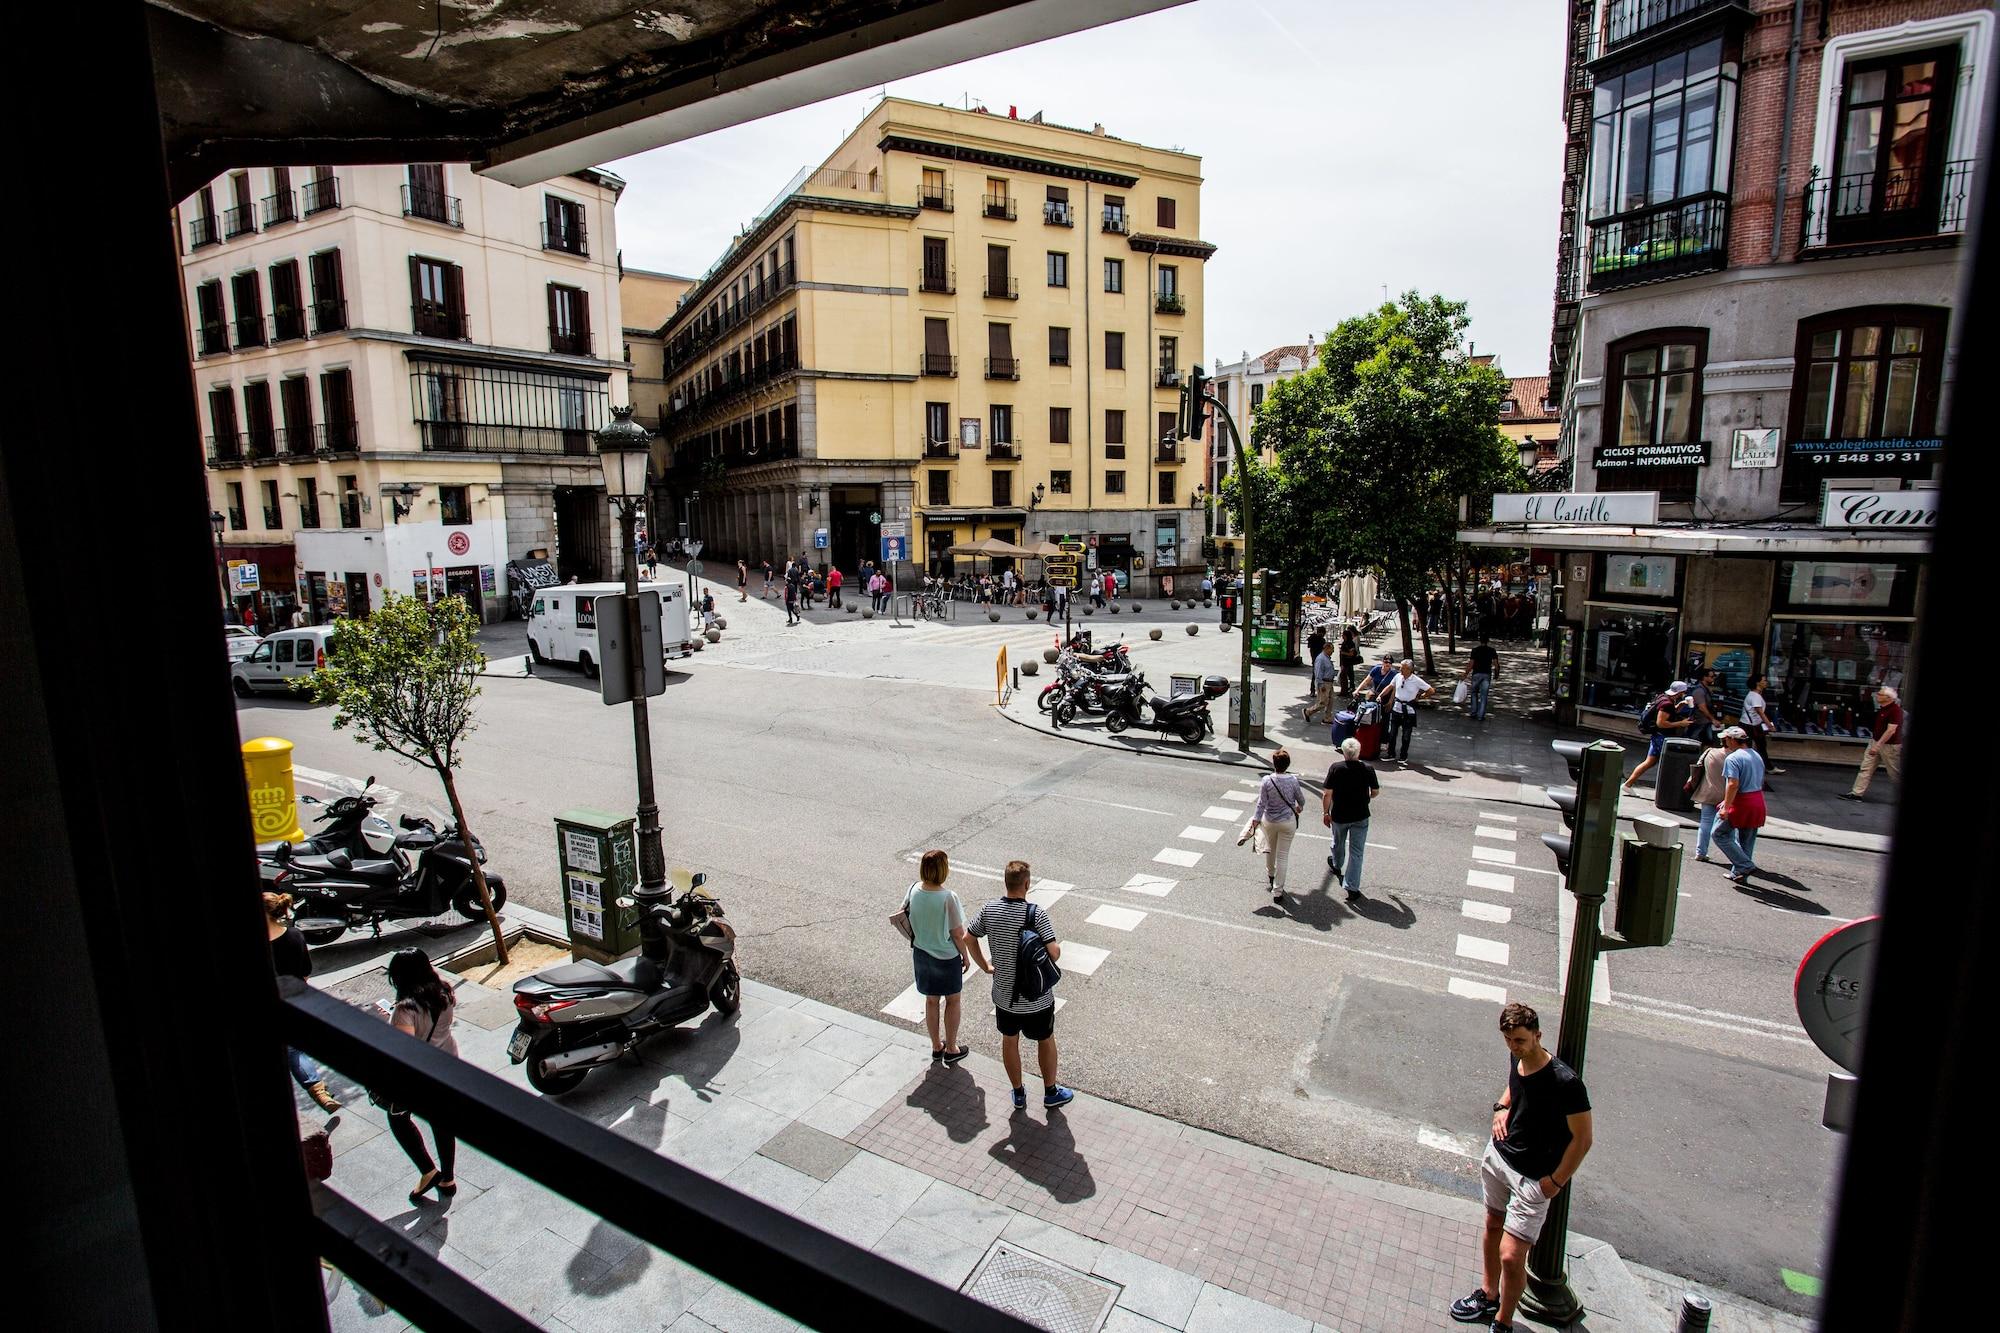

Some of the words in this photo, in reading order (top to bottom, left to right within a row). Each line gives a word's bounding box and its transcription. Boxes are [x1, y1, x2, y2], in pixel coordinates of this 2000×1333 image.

[1603, 448, 1635, 457] CICLOS
[1637, 444, 1702, 456] FORMATIVOS
[1743, 451, 1769, 459] CALLE
[1595, 459, 1628, 467] Admon
[1636, 455, 1706, 467] INFORMÁTICA
[1812, 454, 1831, 463] 91
[1838, 453, 1869, 463] 548
[1874, 452, 1896, 462] 39
[1901, 452, 1921, 461] 31
[1525, 496, 1543, 521] El
[1554, 495, 1610, 522] Castillo
